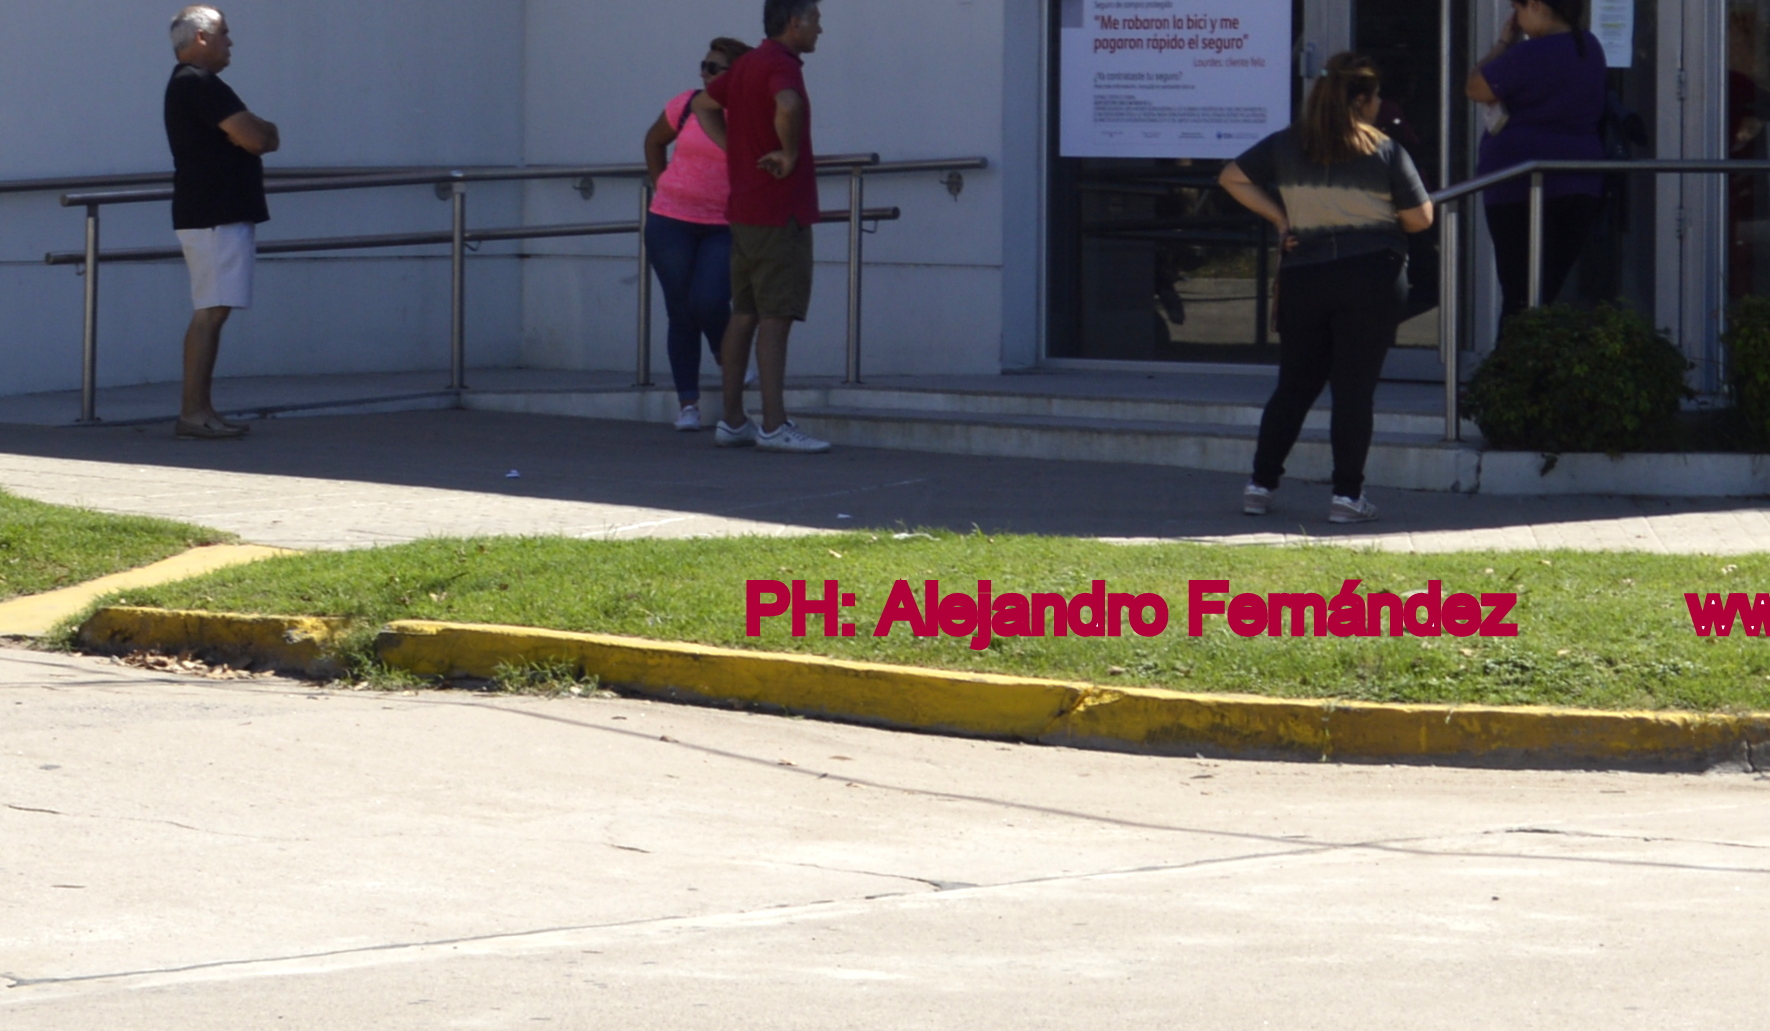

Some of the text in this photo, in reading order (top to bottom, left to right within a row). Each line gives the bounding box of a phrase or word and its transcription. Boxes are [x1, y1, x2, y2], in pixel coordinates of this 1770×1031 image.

[1122, 15, 1170, 30] robaron
[1173, 15, 1184, 30] la
[1187, 14, 1207, 30] bici
[1210, 18, 1217, 33] y
[1220, 17, 1239, 30] me
[1094, 36, 1143, 53] pagaron
[1147, 34, 1185, 53] rápido
[1188, 34, 1198, 49] el
